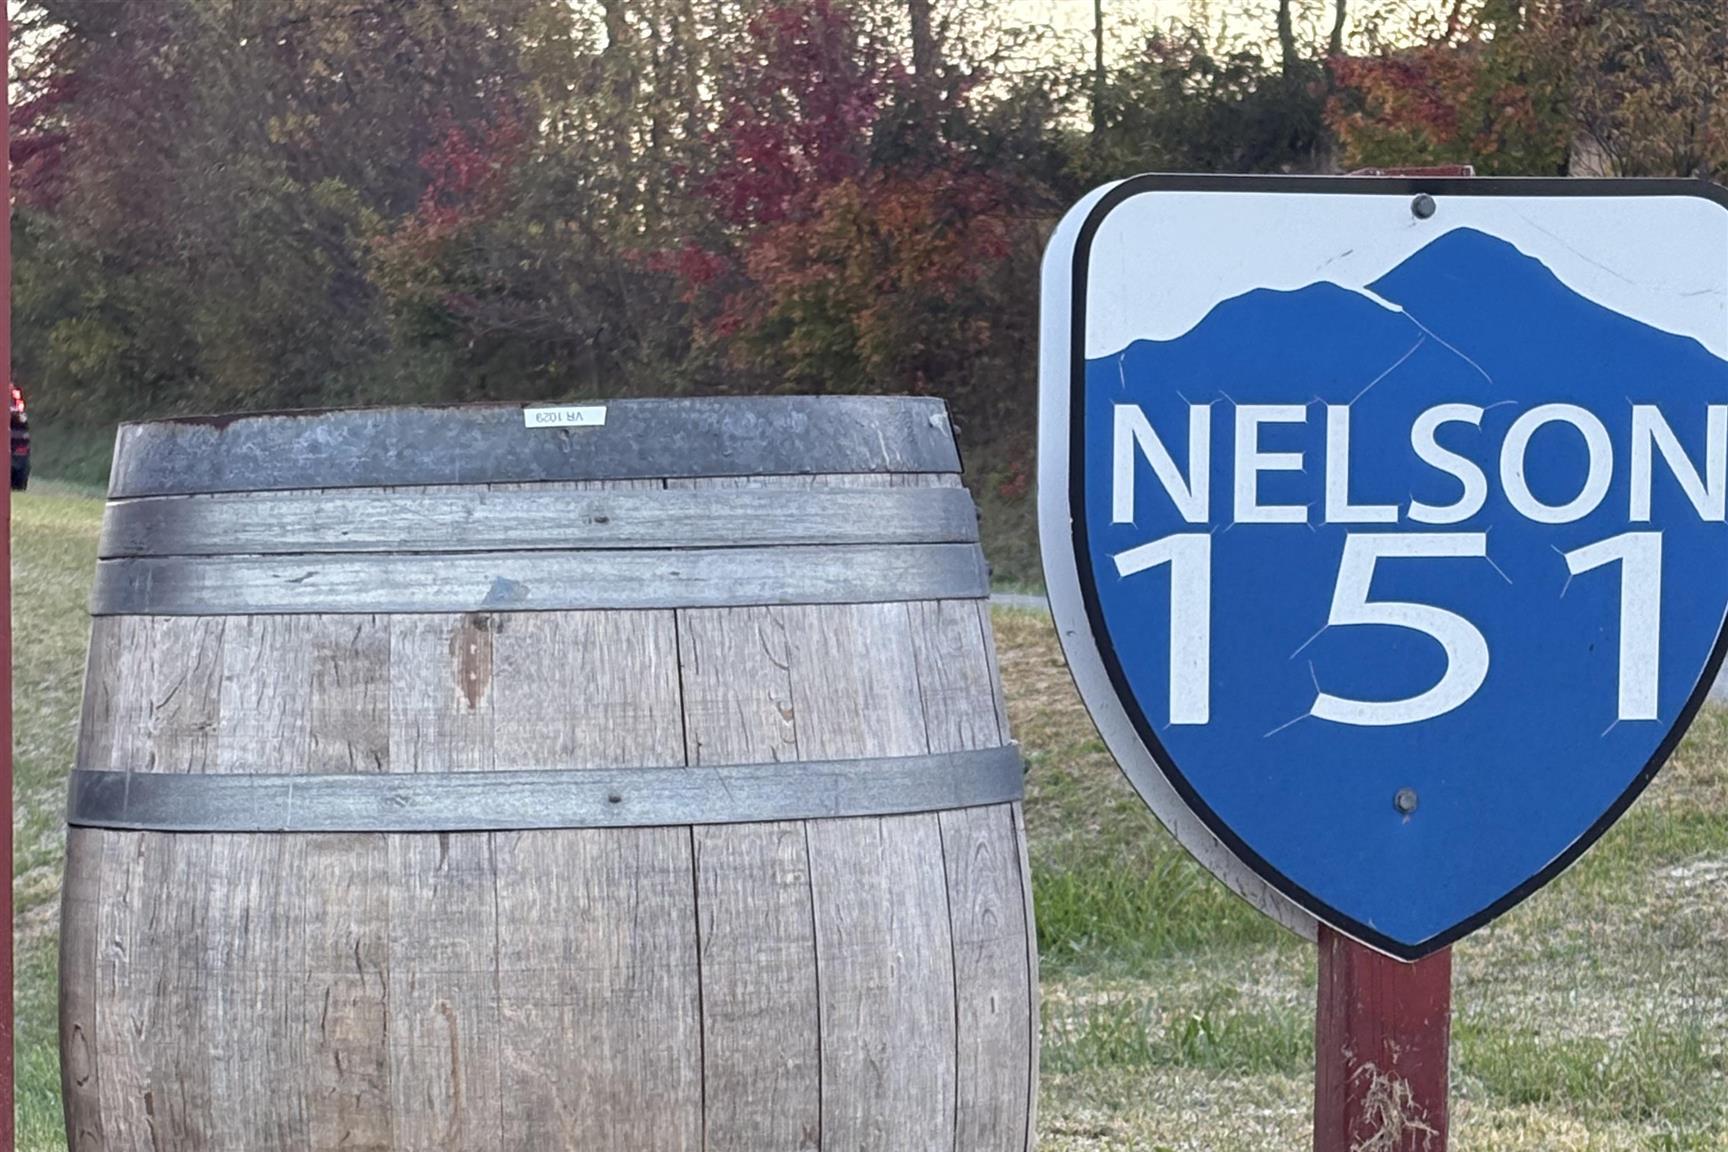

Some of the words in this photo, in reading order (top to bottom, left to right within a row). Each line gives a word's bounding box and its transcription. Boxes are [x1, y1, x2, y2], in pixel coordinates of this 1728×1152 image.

[535, 411, 562, 424] 1029
[566, 411, 584, 422] VR
[1112, 403, 1728, 523] NELSON
[1112, 531, 1662, 727] 151
